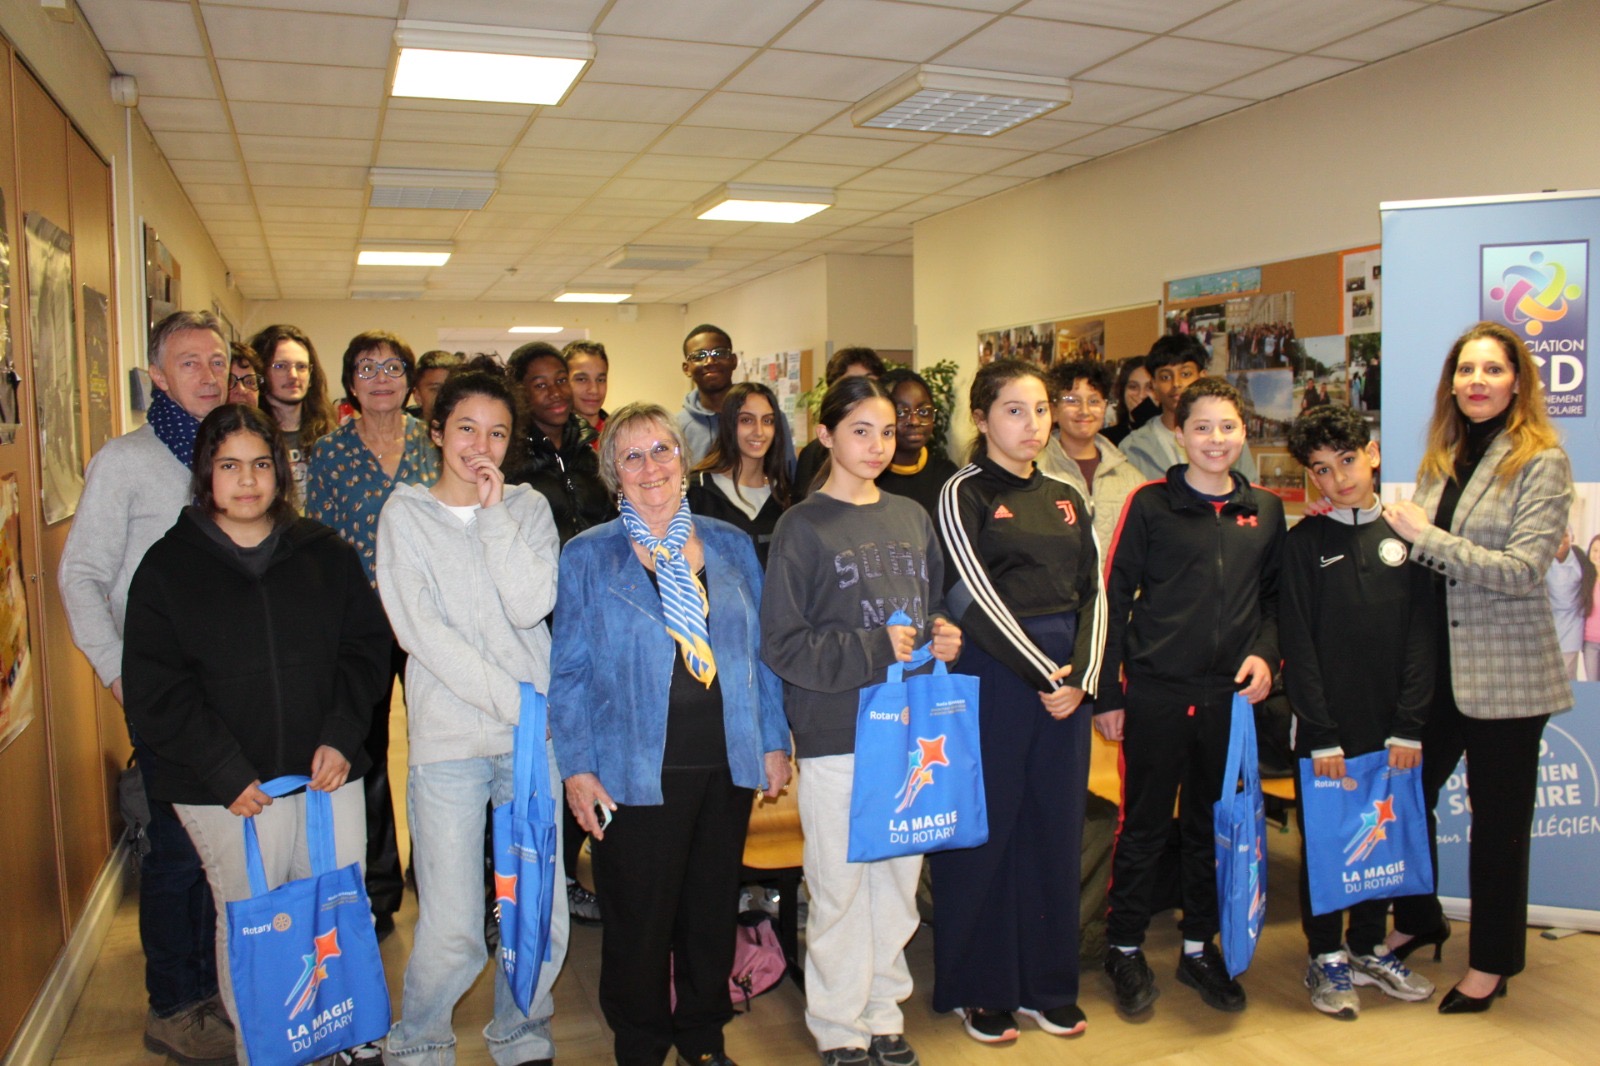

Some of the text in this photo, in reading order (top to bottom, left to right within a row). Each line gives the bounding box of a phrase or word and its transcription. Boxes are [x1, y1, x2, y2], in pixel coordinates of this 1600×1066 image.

[870, 710, 899, 722] Rotary
[1314, 779, 1341, 789] Rotary
[889, 810, 958, 832] LA MAGIE
[890, 825, 957, 844] DU ROTARY
[1342, 860, 1405, 883] LA MAGIE
[1345, 875, 1405, 894] DU ROTARY
[242, 922, 272, 936] Rotary
[287, 997, 354, 1041] LA MAGIE
[292, 1037, 312, 1053] DU
[314, 1012, 354, 1042] ROTARY
